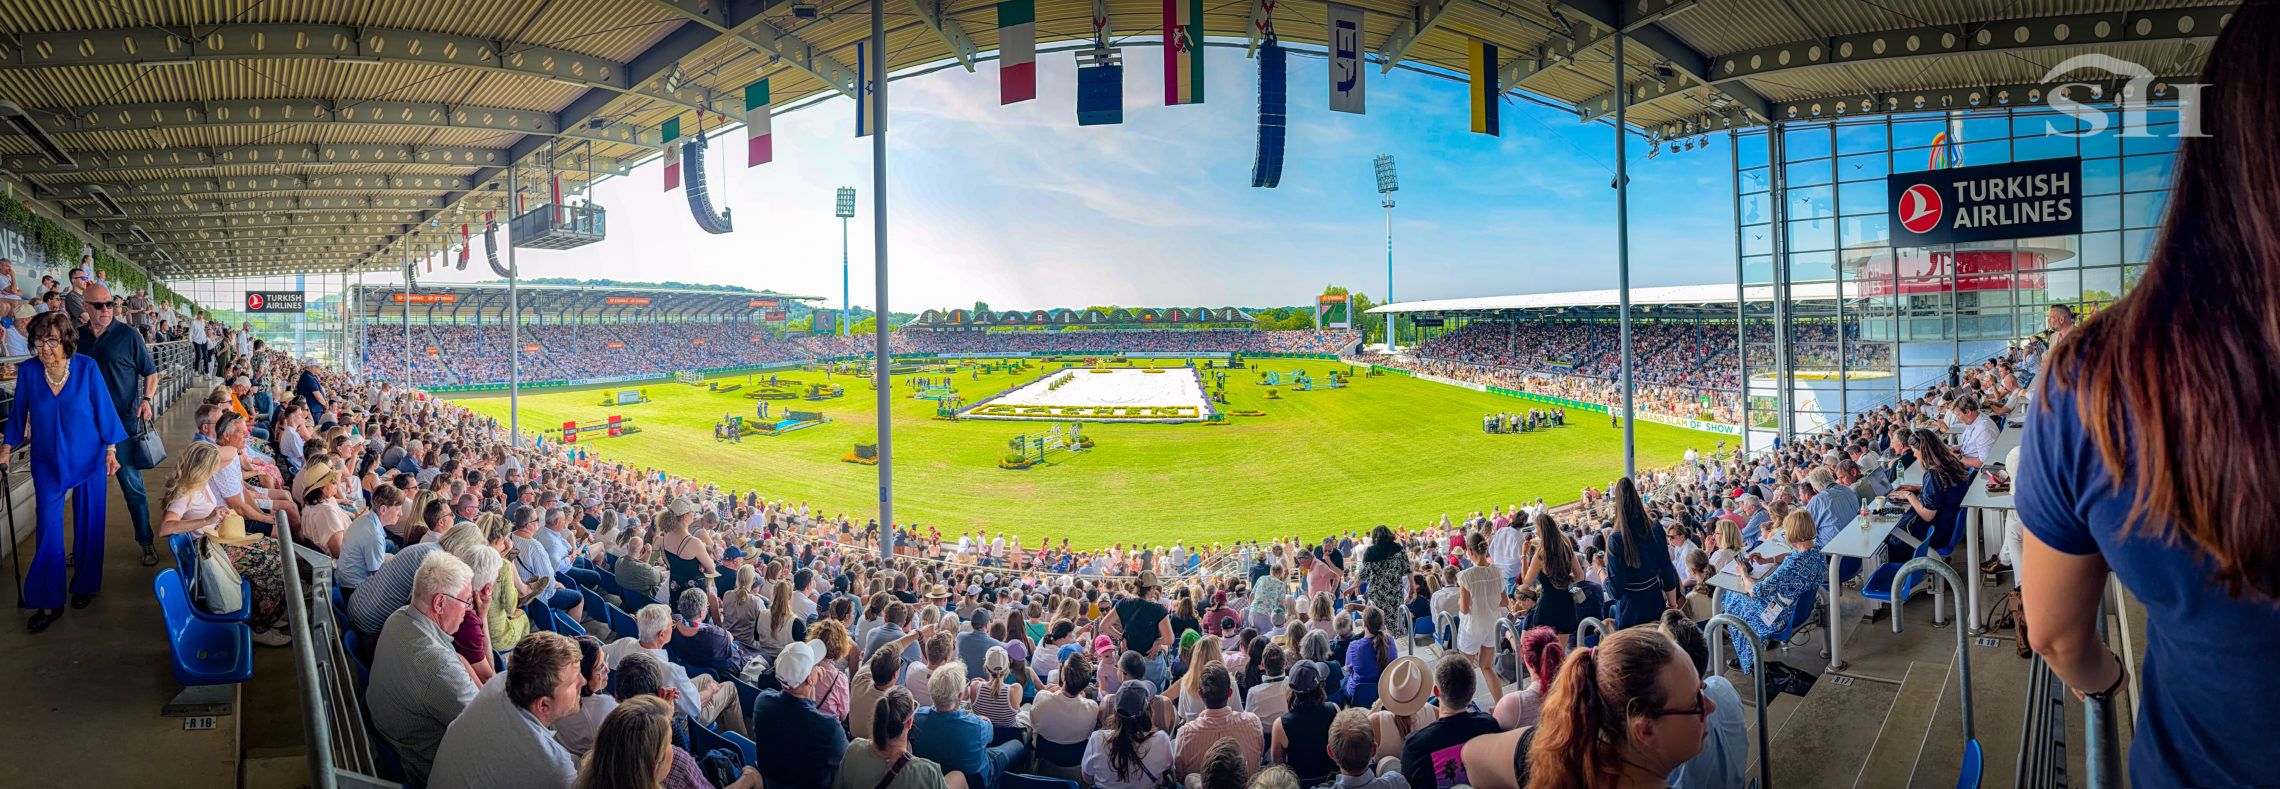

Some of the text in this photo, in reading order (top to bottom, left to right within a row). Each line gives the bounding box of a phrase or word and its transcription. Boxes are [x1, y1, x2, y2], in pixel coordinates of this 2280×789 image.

[1953, 172, 2070, 203] TURKISH
[1953, 199, 2073, 229] AIRLINES
[266, 294, 302, 302] TURKISH
[1638, 411, 1665, 423] GRAND
[1666, 416, 1688, 428] SLAM
[1690, 420, 1701, 429] OF
[1706, 423, 1734, 435] SHOW
[190, 717, 212, 728] R 19
